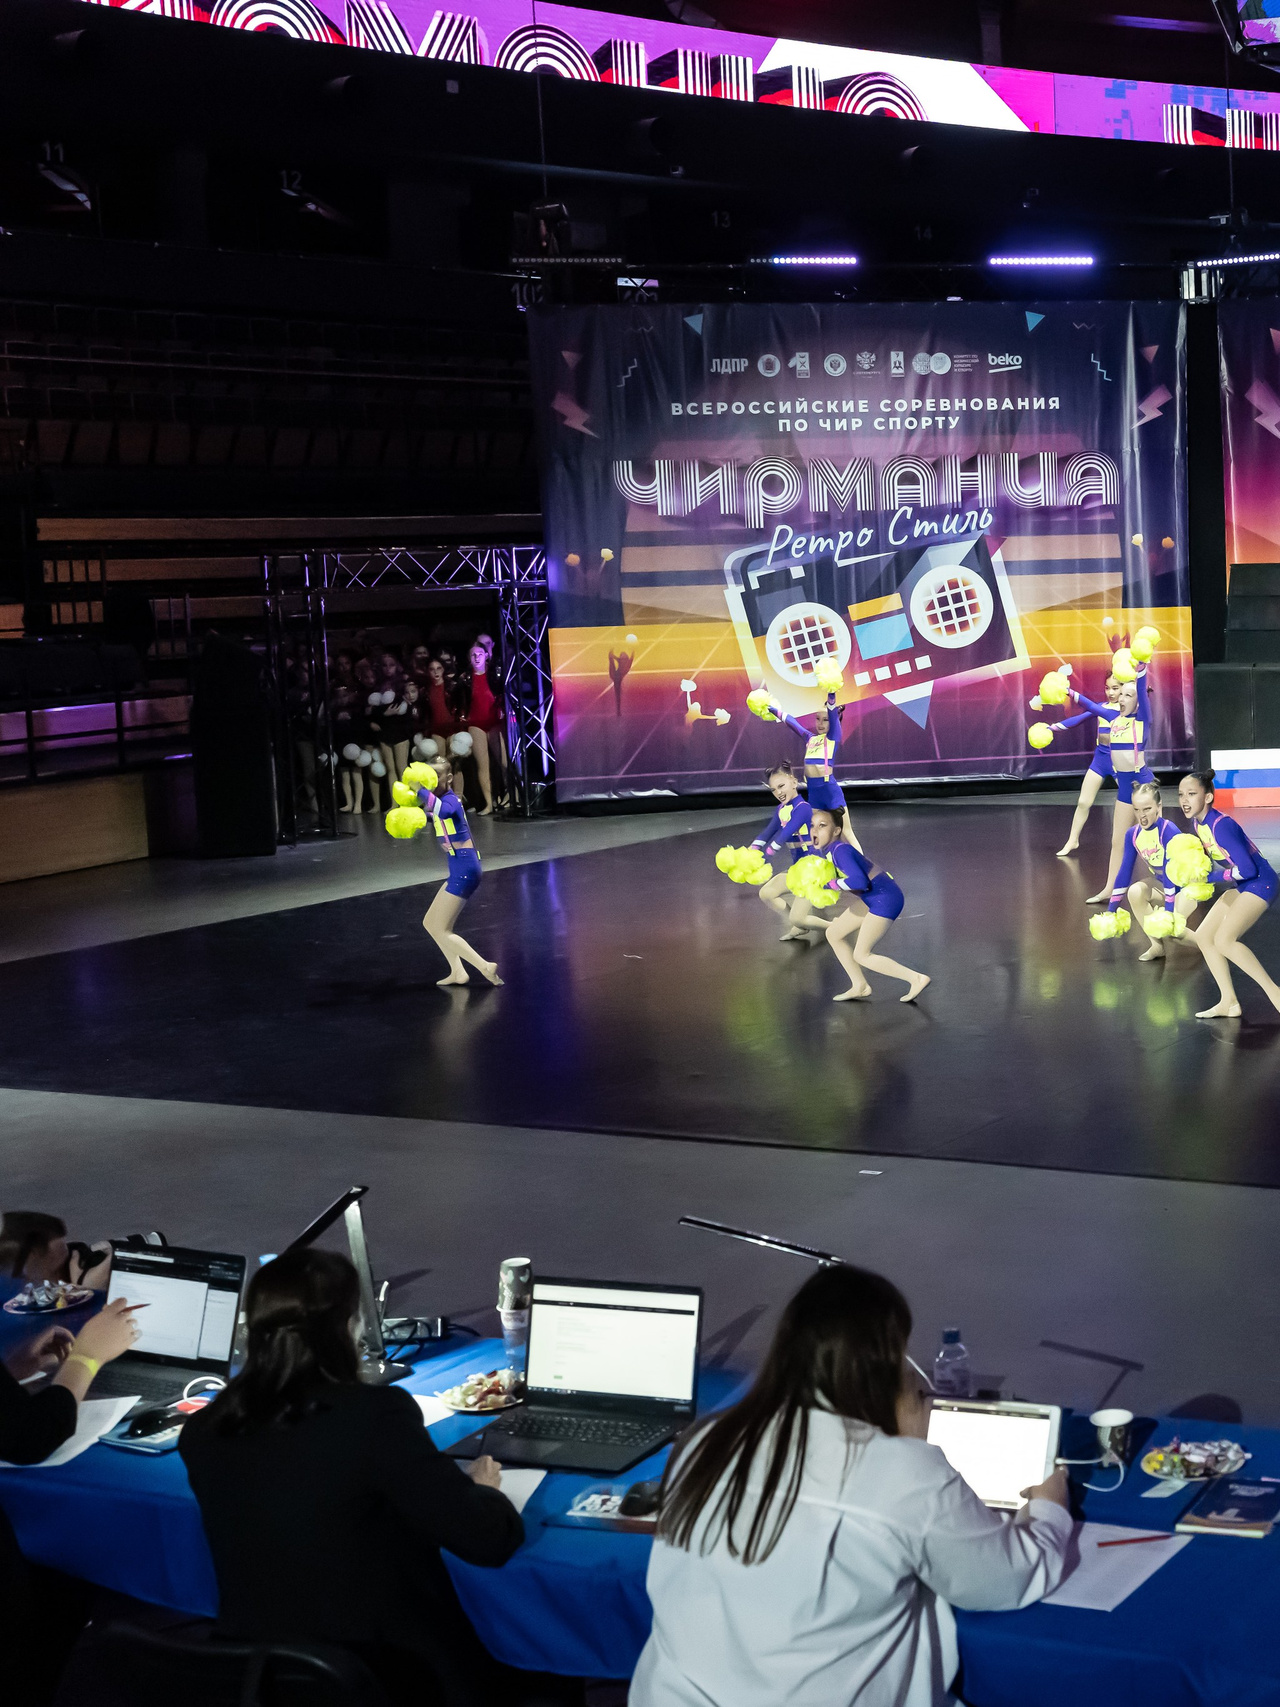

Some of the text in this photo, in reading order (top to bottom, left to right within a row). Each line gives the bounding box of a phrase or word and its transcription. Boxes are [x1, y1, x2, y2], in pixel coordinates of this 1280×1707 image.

[40, 141, 64, 163] 11
[280, 170, 303, 190] 12
[711, 210, 731, 228] 13
[710, 358, 749, 375] ЛДПР
[987, 353, 1023, 366] beko
[671, 396, 1061, 416] ВСЕРОССИЙСКИЕ СОРЕВНОВАНИЯ
[778, 415, 961, 432] ПО ЧИР СПОРТУ
[766, 505, 994, 566] Ретро Стиль
